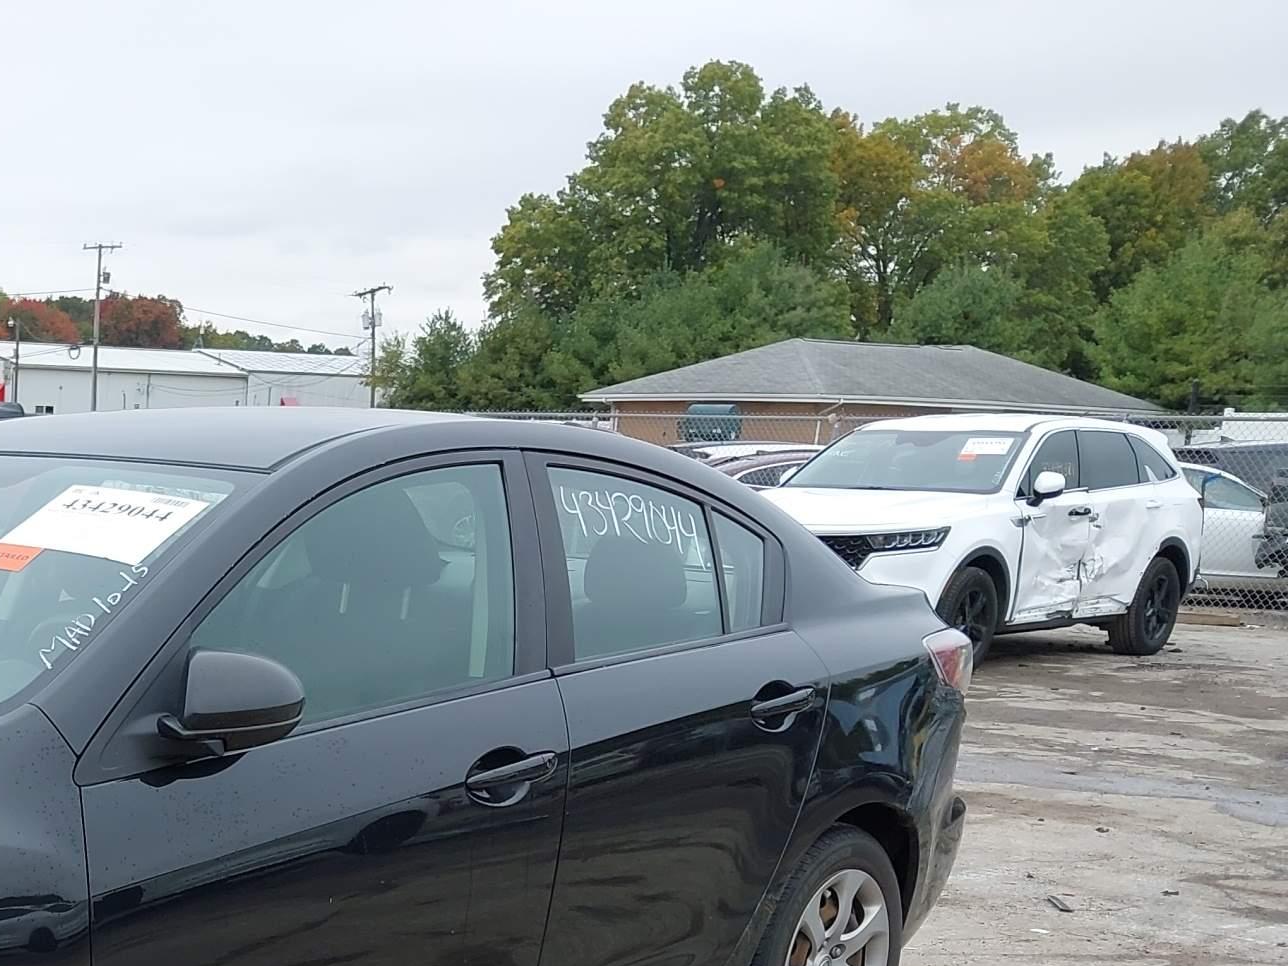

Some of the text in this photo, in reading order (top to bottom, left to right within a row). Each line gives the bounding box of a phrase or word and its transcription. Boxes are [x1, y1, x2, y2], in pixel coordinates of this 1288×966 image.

[62, 498, 174, 522] 43429044
[559, 486, 706, 570] 43429044
[39, 612, 96, 670] MAD
